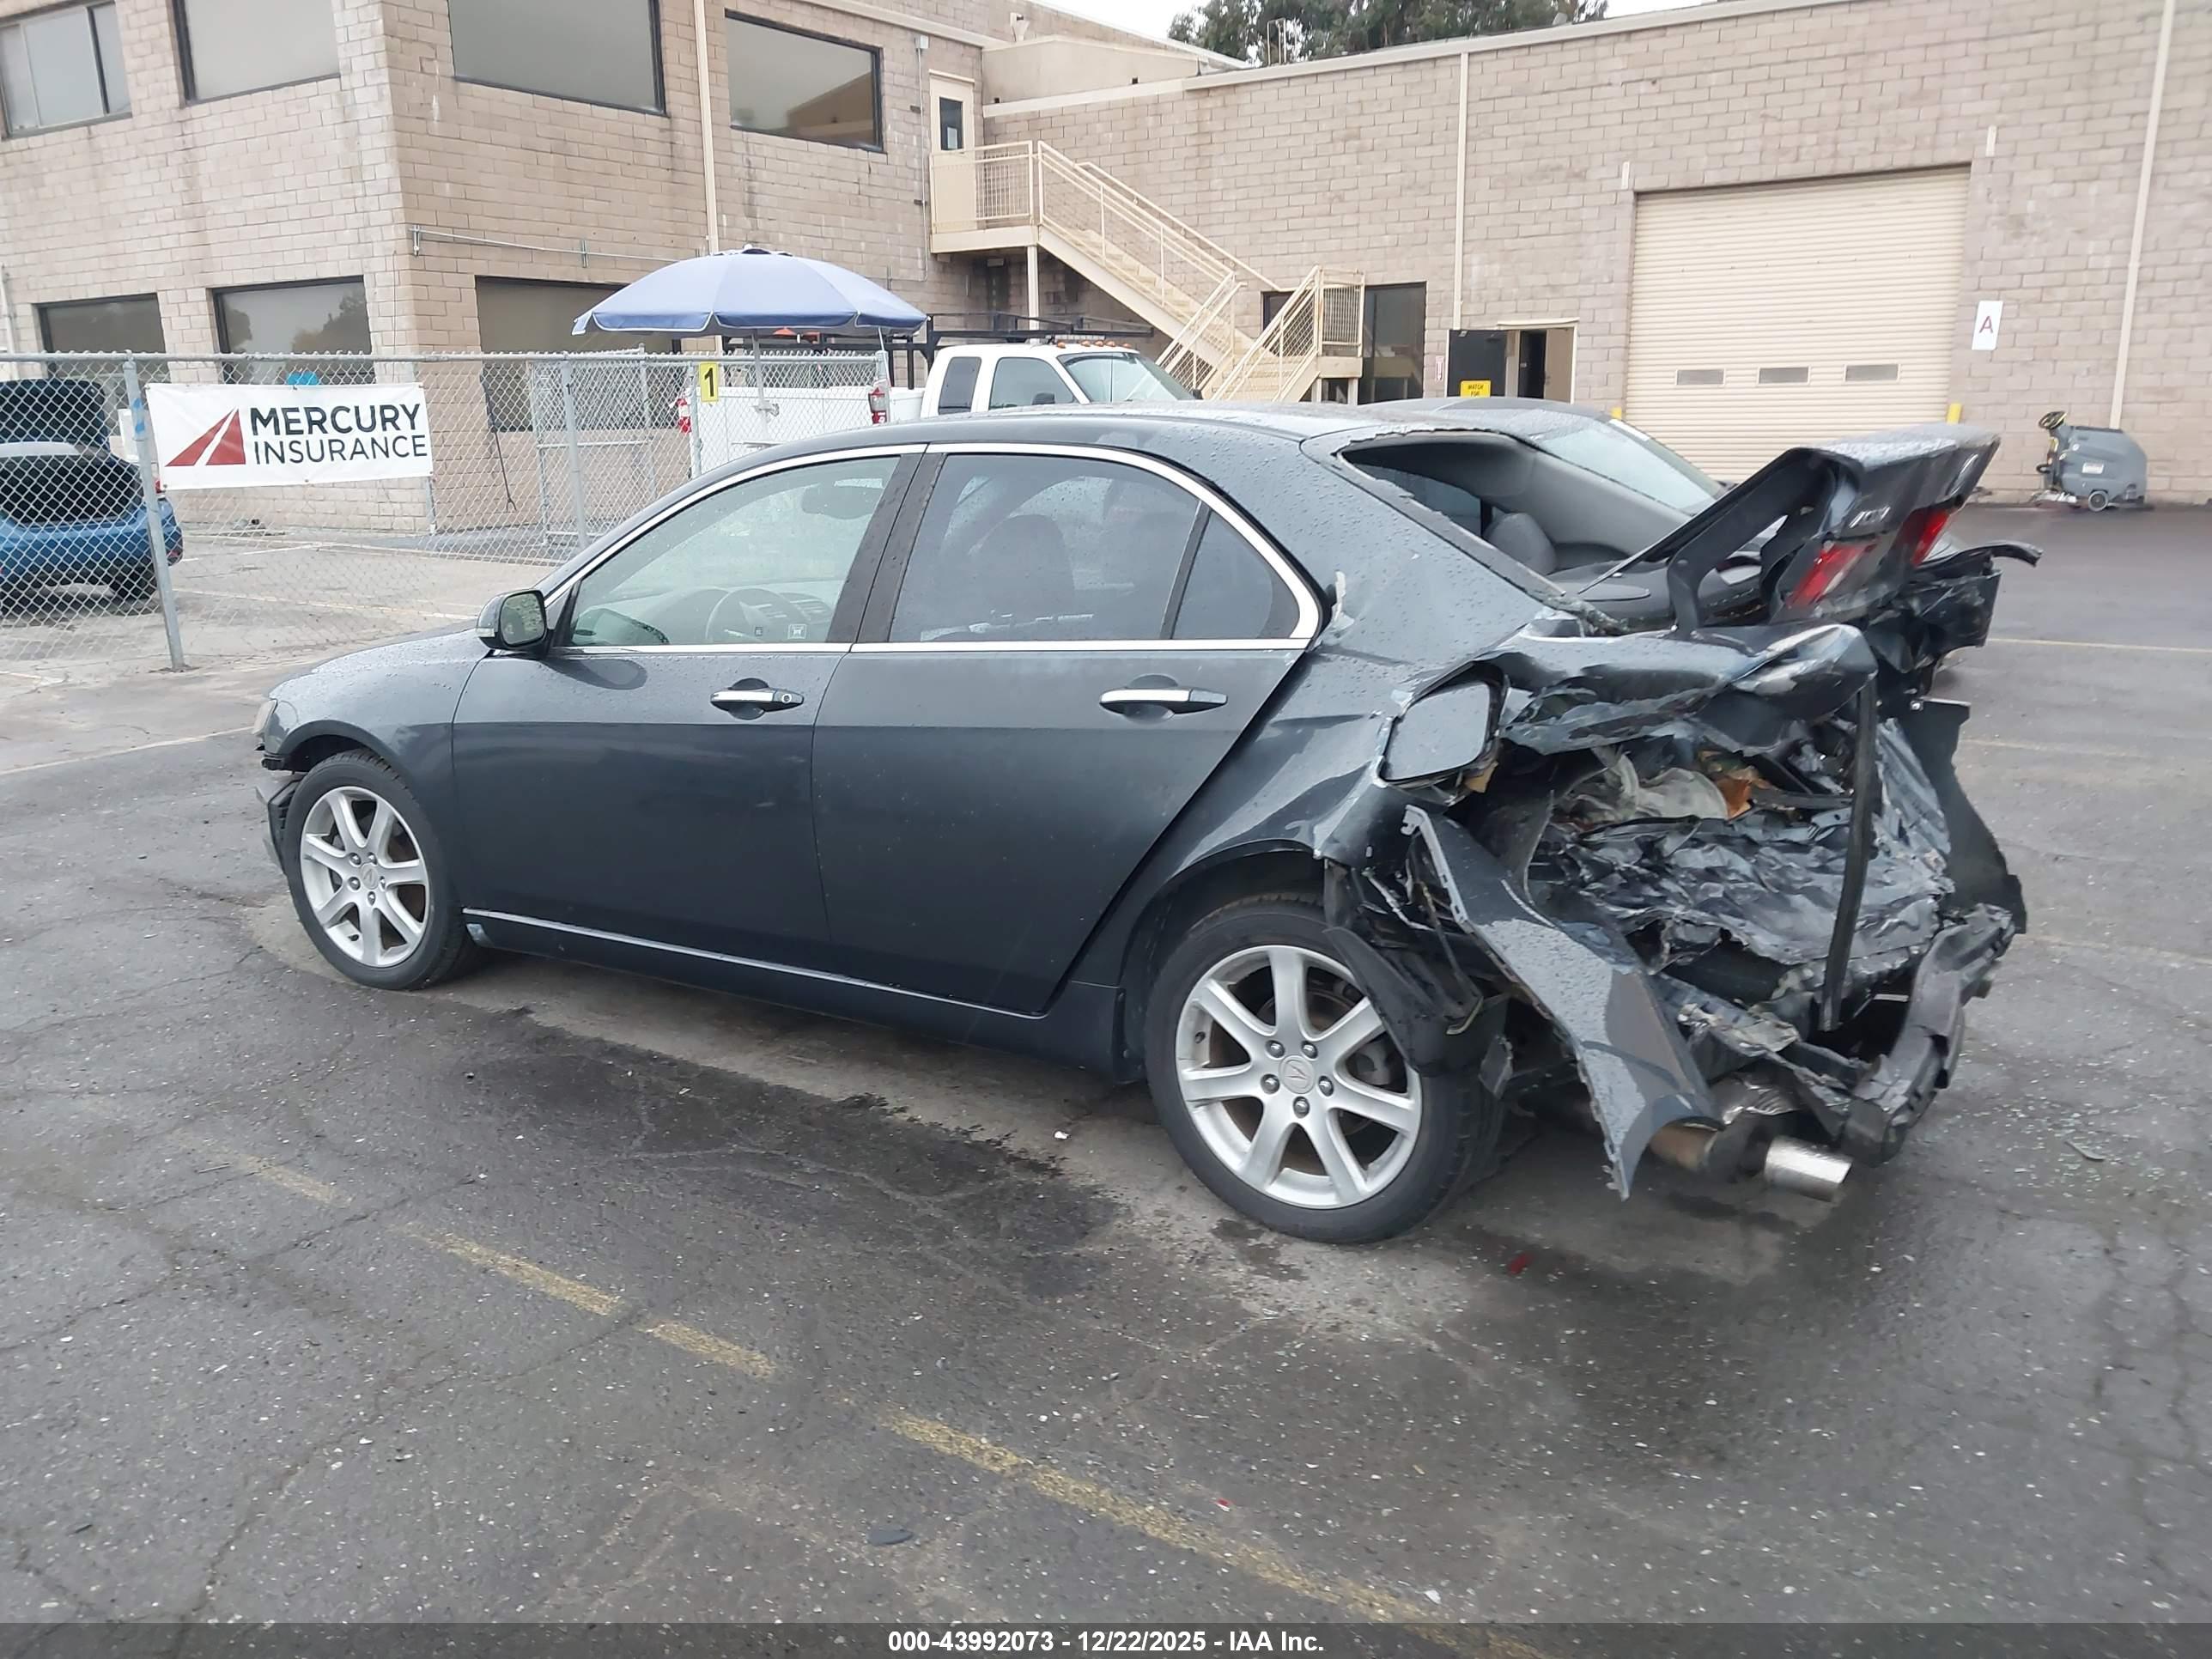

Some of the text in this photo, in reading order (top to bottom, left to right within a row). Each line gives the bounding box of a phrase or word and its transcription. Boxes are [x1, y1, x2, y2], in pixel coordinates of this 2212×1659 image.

[1978, 315, 1994, 334] A
[704, 368, 714, 398] 1
[250, 404, 421, 436] MERCURY
[253, 434, 428, 465] INSURANCE
